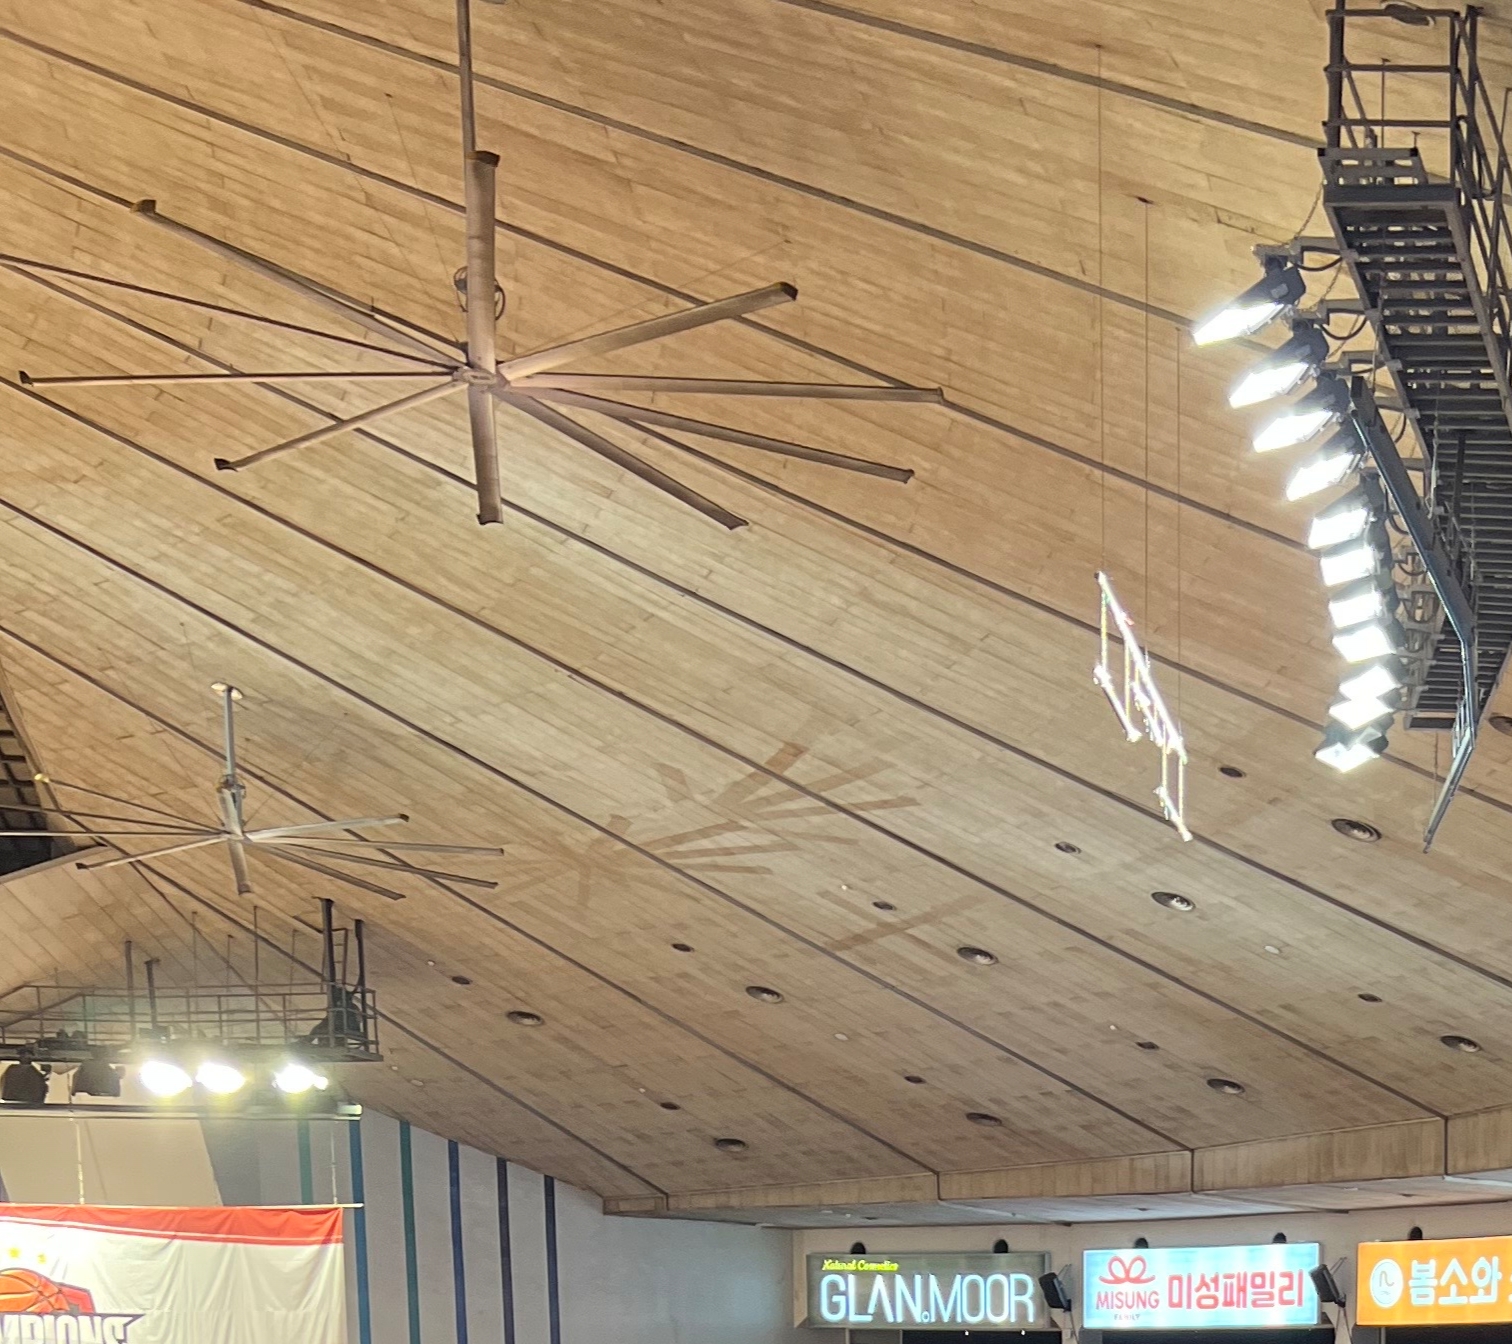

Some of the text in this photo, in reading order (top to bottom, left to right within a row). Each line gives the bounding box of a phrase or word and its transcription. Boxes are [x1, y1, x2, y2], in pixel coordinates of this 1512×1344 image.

[1095, 1289, 1160, 1311] MISUNG
[1167, 1270, 1304, 1311] 미성패밀리
[1407, 1256, 1502, 1308] 봄소와
